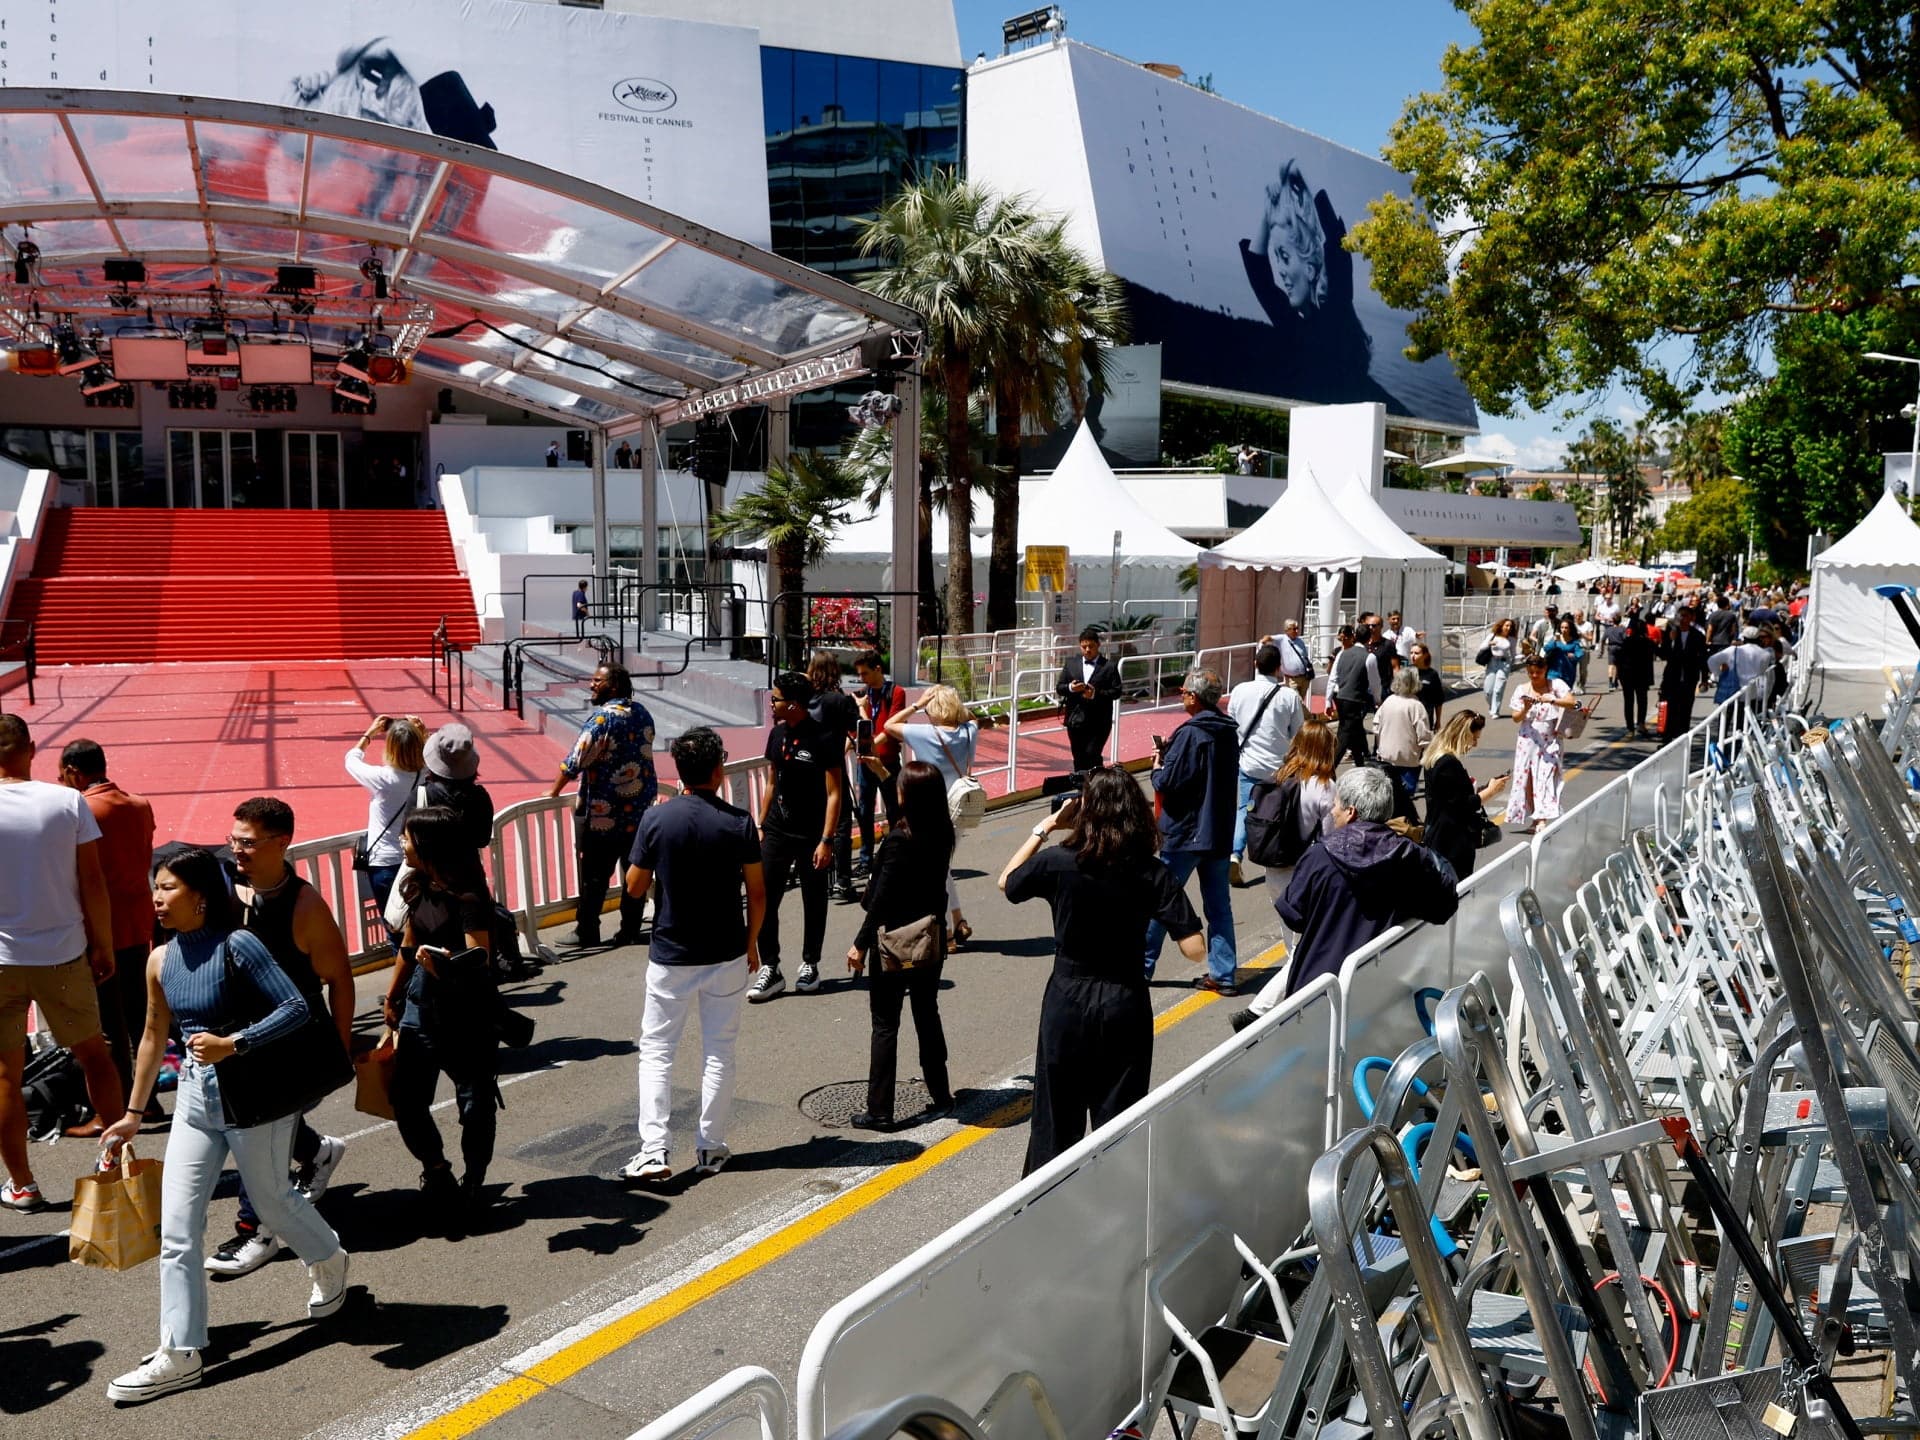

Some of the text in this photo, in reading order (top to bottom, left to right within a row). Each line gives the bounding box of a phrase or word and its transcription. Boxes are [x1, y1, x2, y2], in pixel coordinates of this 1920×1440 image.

[598, 112, 693, 128] FESTIVAL DE CANNES
